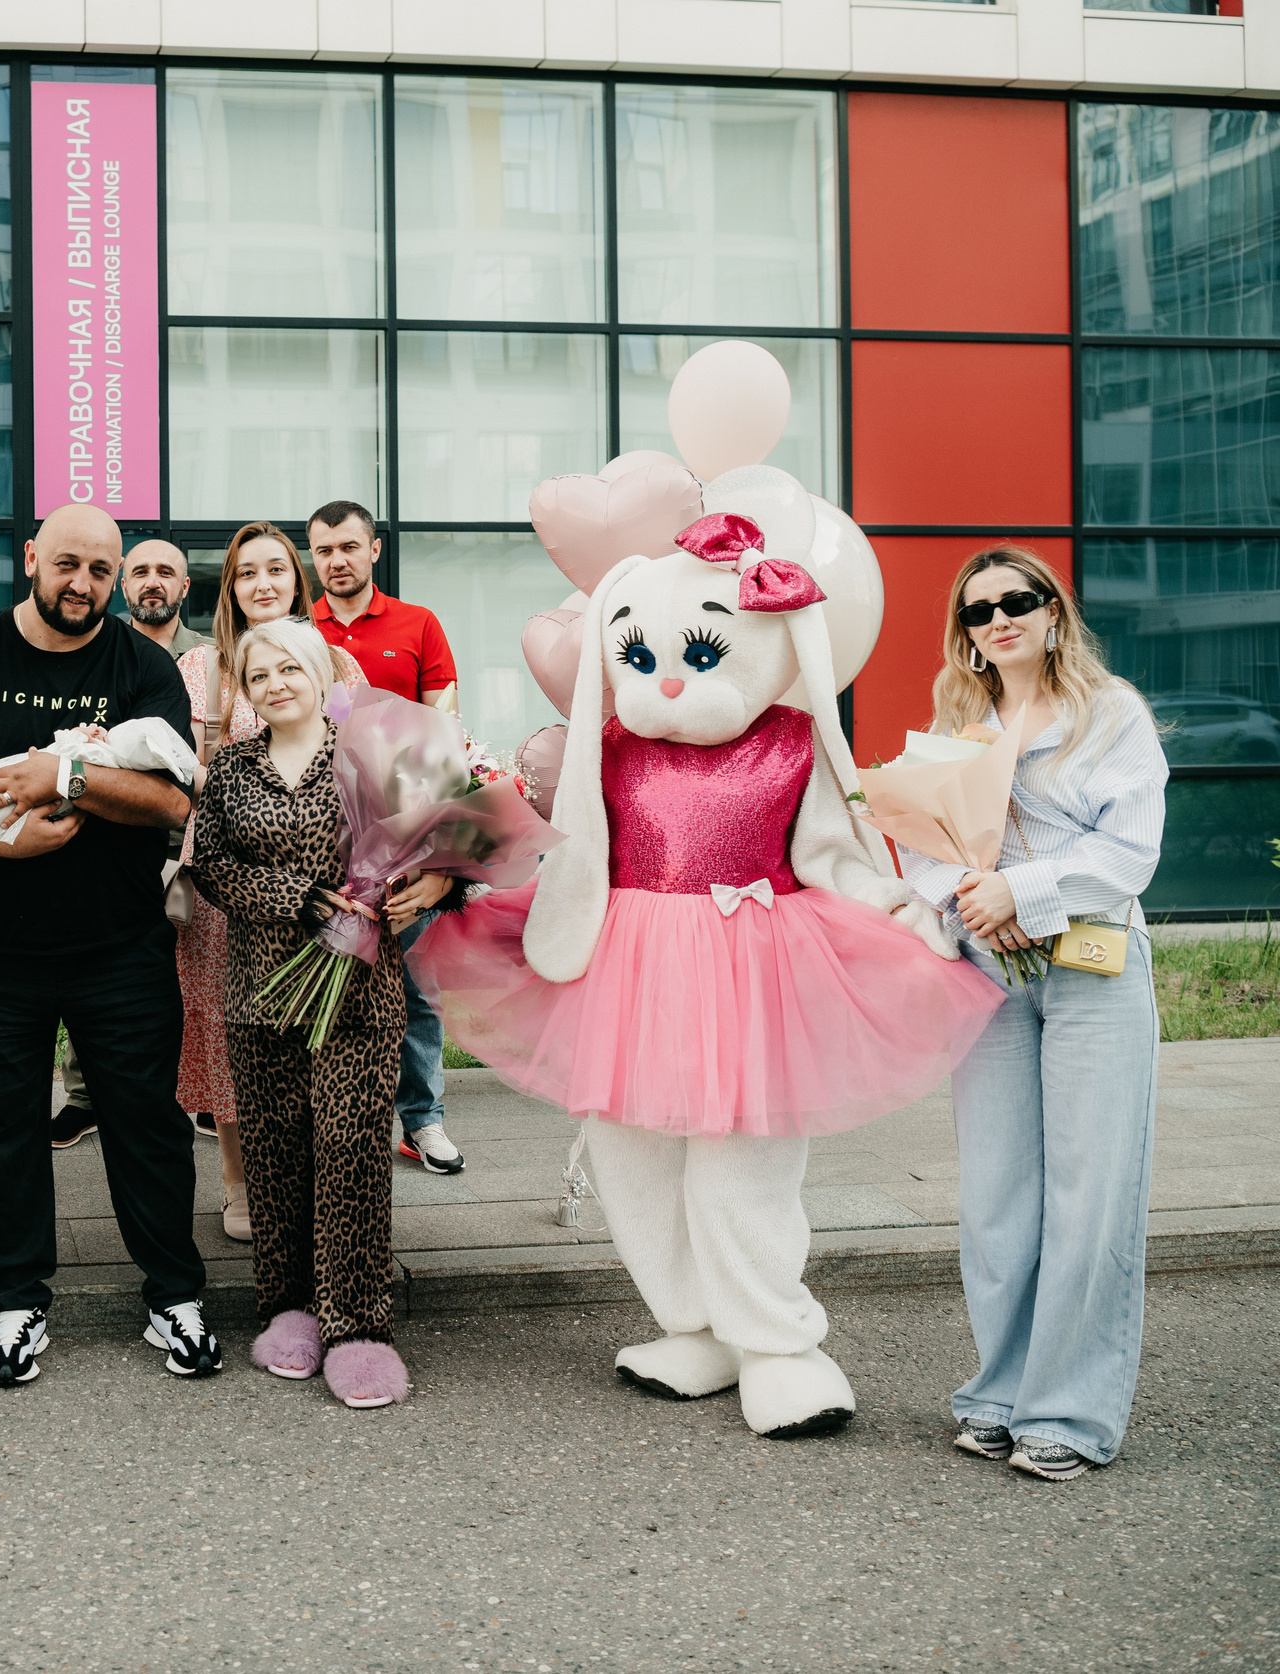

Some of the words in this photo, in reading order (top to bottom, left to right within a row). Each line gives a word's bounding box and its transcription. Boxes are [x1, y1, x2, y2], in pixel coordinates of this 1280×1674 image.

[66, 98, 92, 268] ВЫПИСНАЯ
[103, 160, 120, 238] LOUNGE
[67, 278, 97, 289] /
[103, 244, 121, 354] DISCHARGE
[68, 299, 94, 503] СПРАВОЧНАЯ
[105, 359, 124, 368] /
[105, 373, 123, 504] INFORMATION
